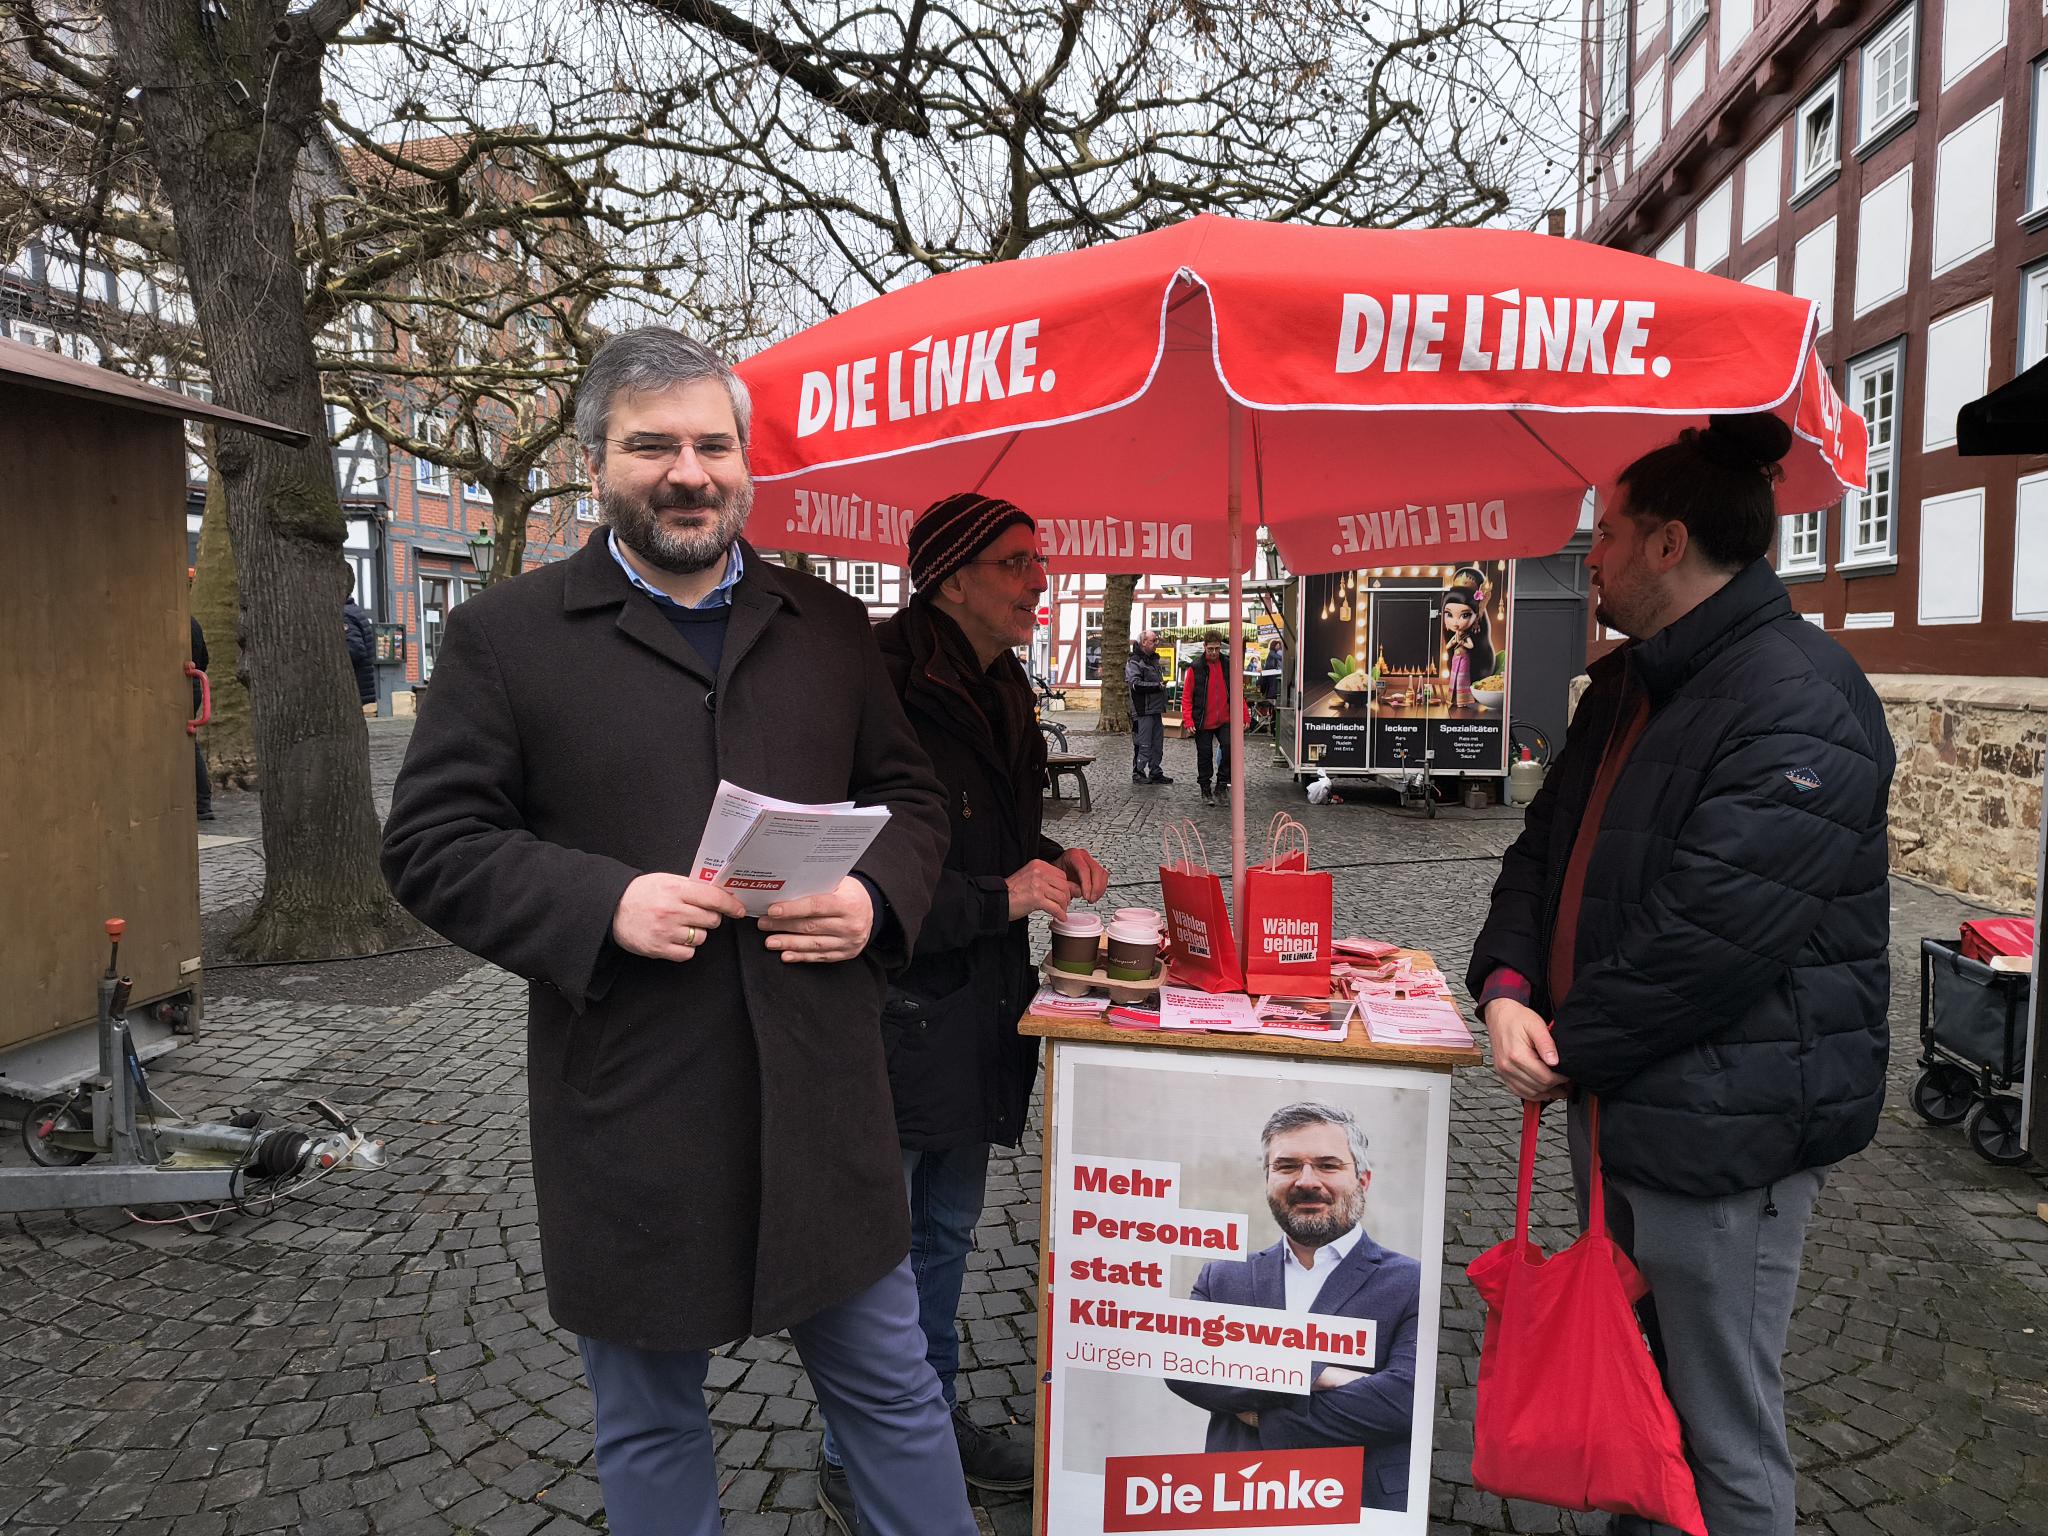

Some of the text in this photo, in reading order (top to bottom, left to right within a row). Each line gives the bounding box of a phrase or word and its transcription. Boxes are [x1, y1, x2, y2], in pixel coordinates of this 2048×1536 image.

[1335, 288, 1672, 378] DIE LINKE.
[797, 318, 1056, 438] DIE LINKE.
[1304, 722, 1365, 732] Thailändische
[1384, 724, 1418, 733] leckere
[1439, 724, 1499, 734] Spezialitäten
[730, 880, 780, 889] Die Linke
[1172, 908, 1207, 935] Wählen
[1262, 917, 1319, 936] Wählen
[1176, 927, 1210, 954] gehen!
[1263, 935, 1319, 954] gehen!
[1281, 953, 1293, 962] DIE
[1073, 1164, 1173, 1199] Mehr
[1072, 1209, 1240, 1252] Personal
[1069, 1256, 1163, 1290] statt
[1069, 1297, 1367, 1357] Kürzungswahn!
[1065, 1340, 1304, 1388] Jürgen Bachmann
[1125, 1460, 1345, 1517] Die Linke
